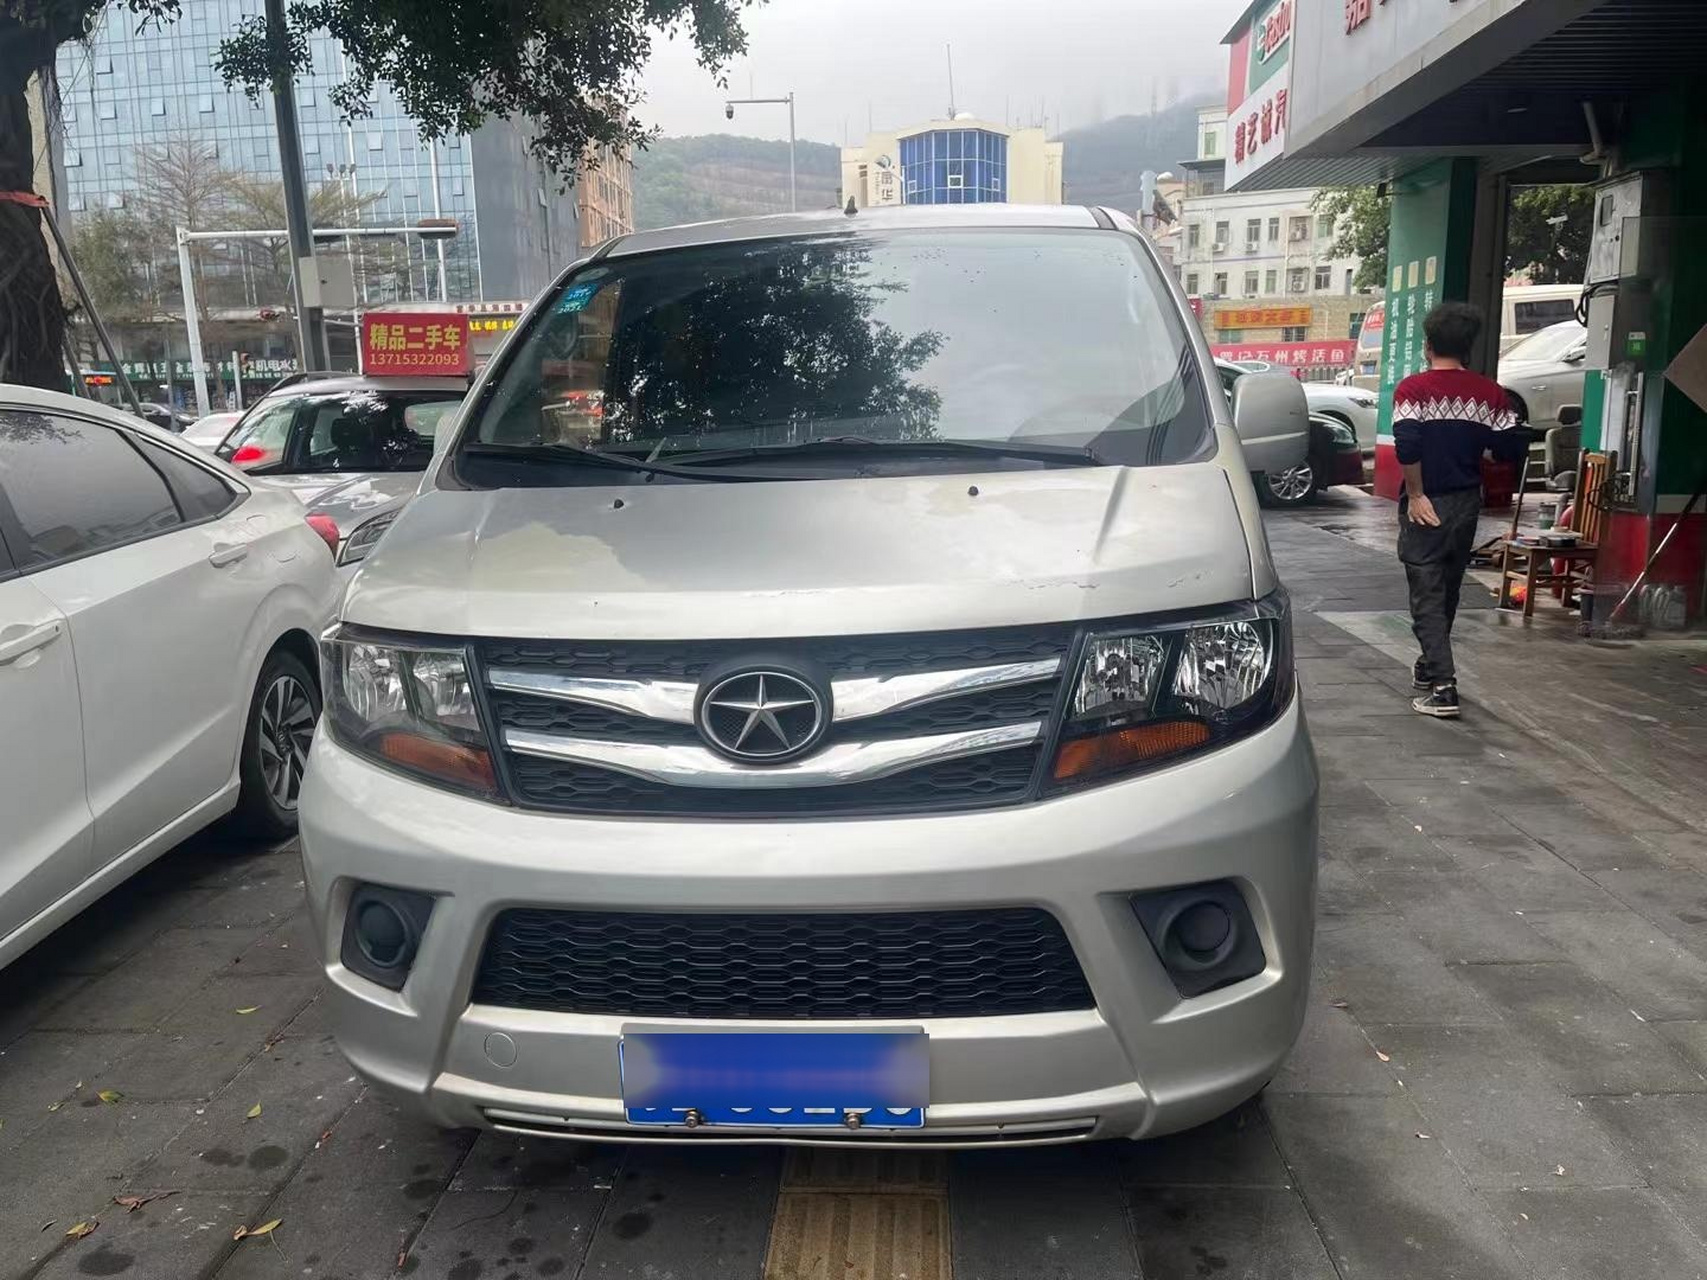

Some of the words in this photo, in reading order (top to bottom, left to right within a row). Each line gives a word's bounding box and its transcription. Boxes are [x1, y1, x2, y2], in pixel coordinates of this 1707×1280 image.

[369, 323, 461, 351] 精品二手车
[370, 353, 460, 366] 13715322093
